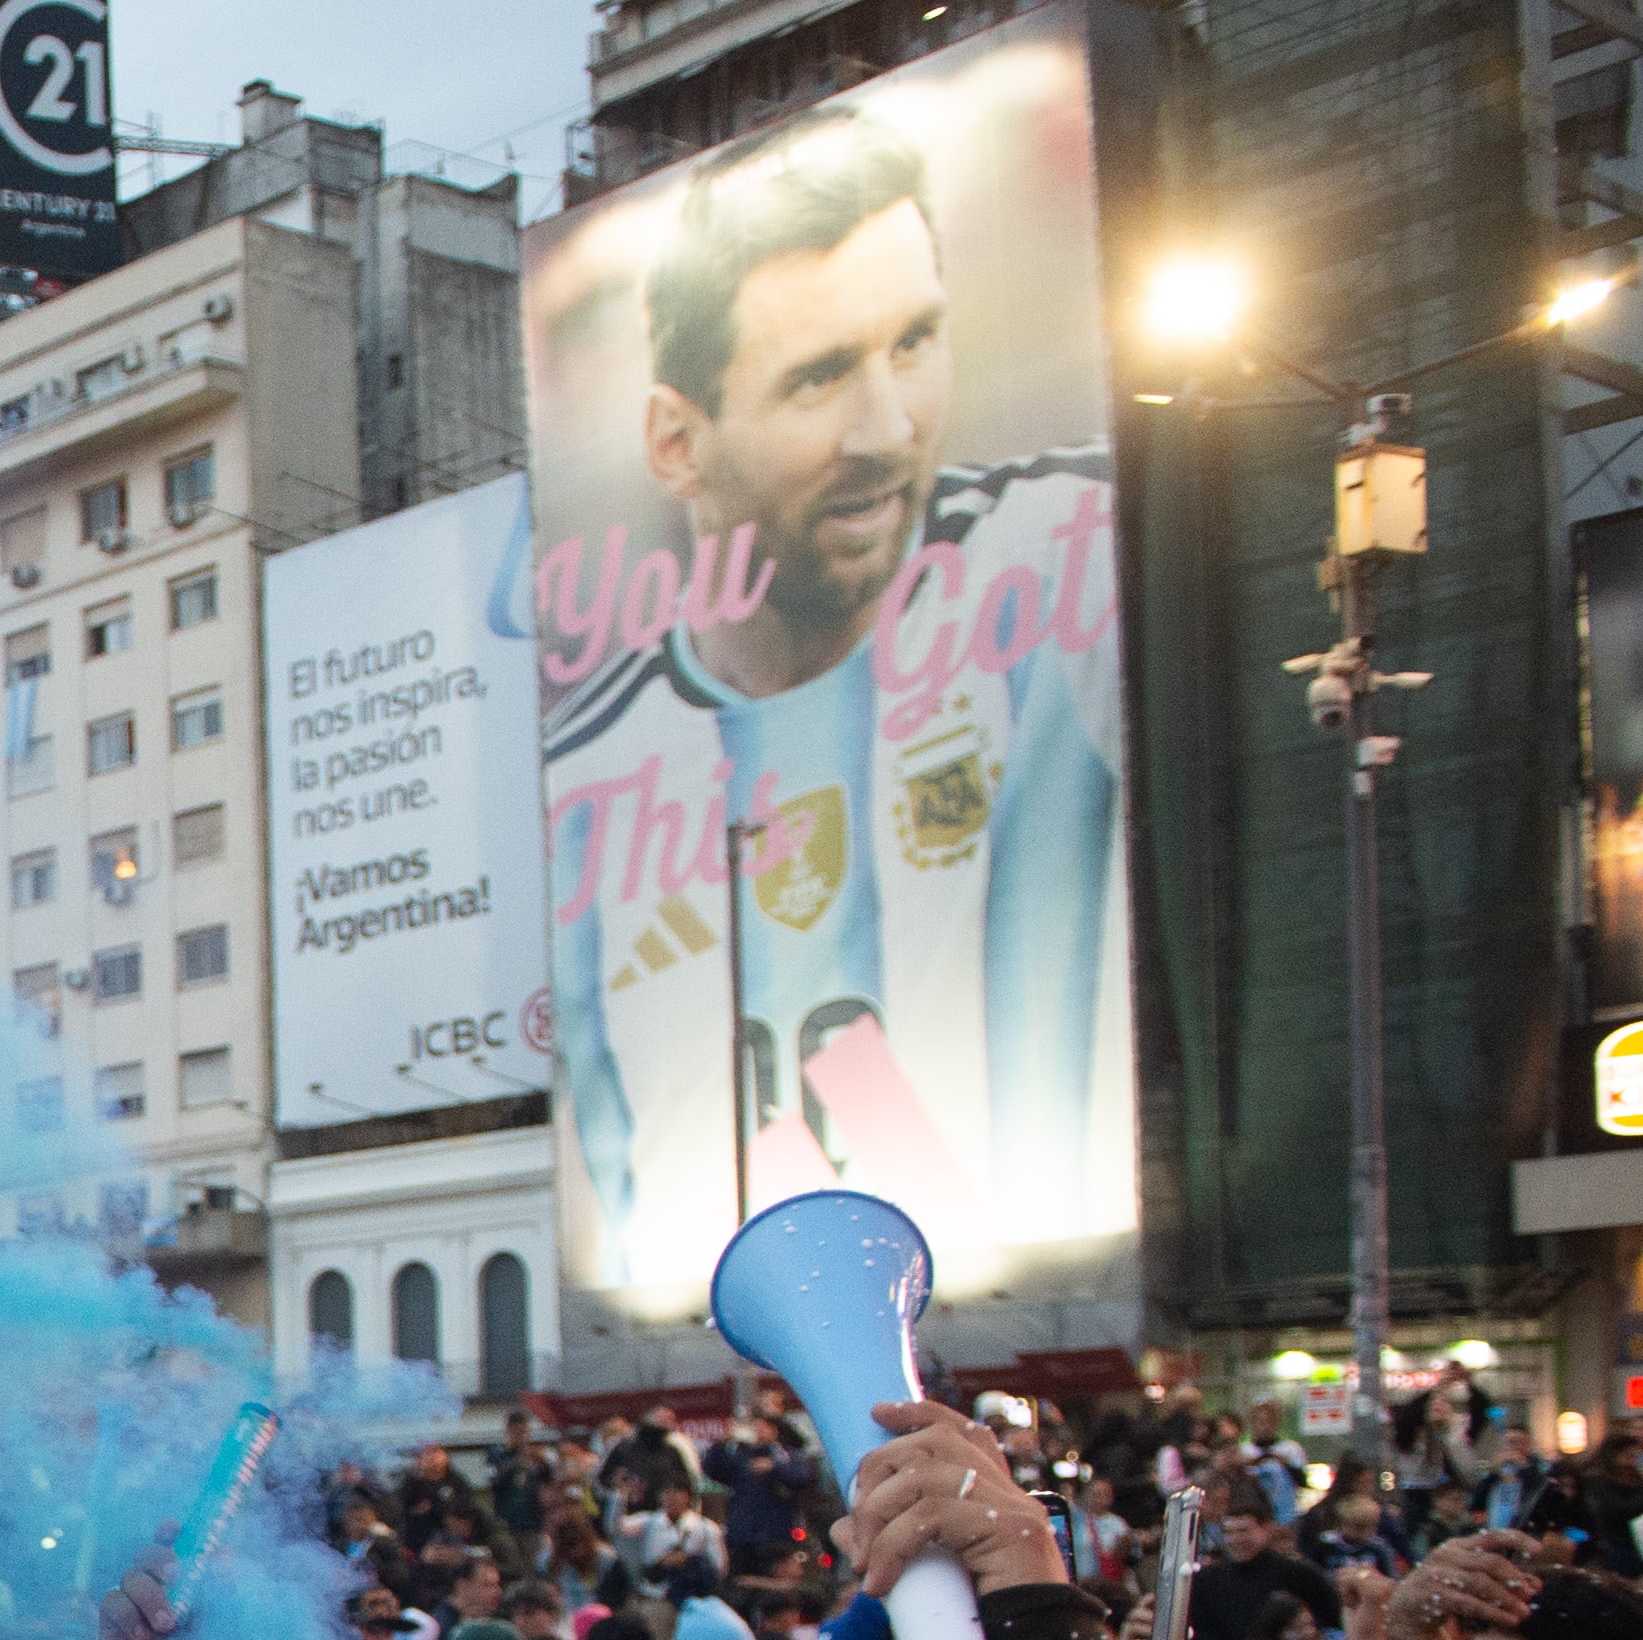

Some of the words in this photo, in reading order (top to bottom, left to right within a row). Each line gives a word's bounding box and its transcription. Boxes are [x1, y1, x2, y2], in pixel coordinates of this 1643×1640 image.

[535, 522, 777, 685] You
[872, 486, 1117, 742] Got
[288, 657, 317, 699] El
[322, 629, 436, 688] futuro
[290, 702, 354, 746] nos
[357, 665, 489, 727] inspira,
[291, 755, 320, 793] la
[324, 725, 443, 791] pasión
[294, 796, 356, 840] nos
[361, 777, 439, 823] une.
[547, 752, 815, 928] This
[294, 847, 432, 915] ¡Vamos
[295, 873, 493, 954] Argentina!
[409, 1008, 507, 1061] ICBC
